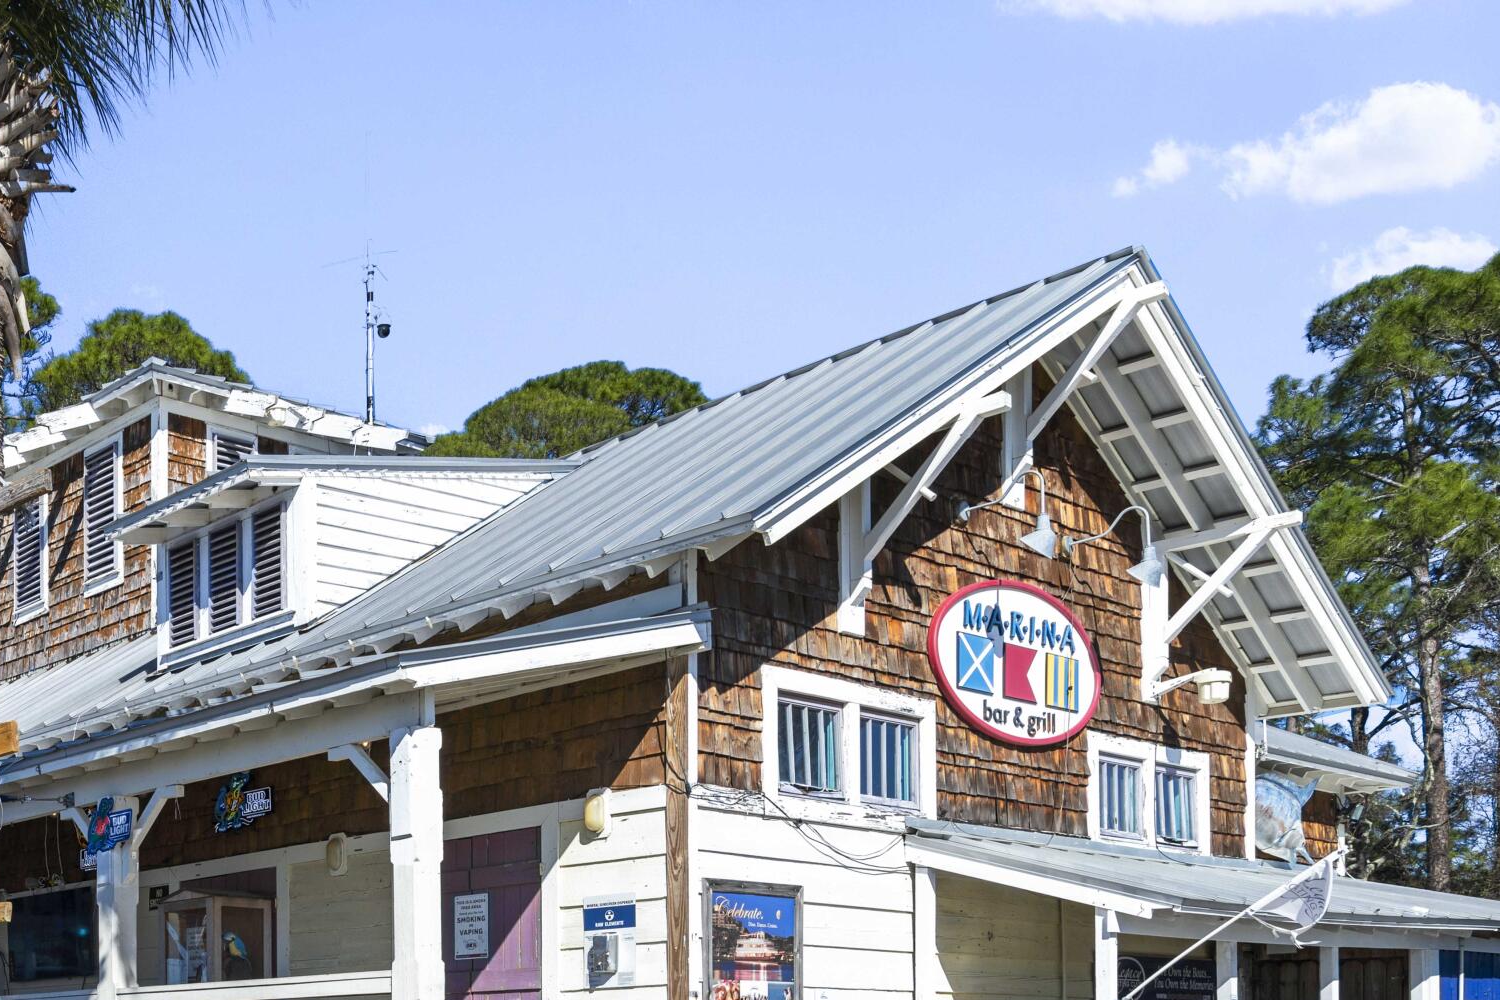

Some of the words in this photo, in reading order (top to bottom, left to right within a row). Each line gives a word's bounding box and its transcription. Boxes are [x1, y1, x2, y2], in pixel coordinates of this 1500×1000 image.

[982, 699, 1010, 725] bar
[1013, 707, 1025, 728] &
[1027, 712, 1056, 737] grill
[246, 791, 266, 803] BUD
[244, 799, 270, 813] LIGHT
[112, 815, 127, 826] BUD
[110, 824, 128, 836] LIGHT
[715, 896, 764, 919] Celebrate.
[456, 915, 486, 923] SMOKING
[460, 928, 484, 936] VAPING
